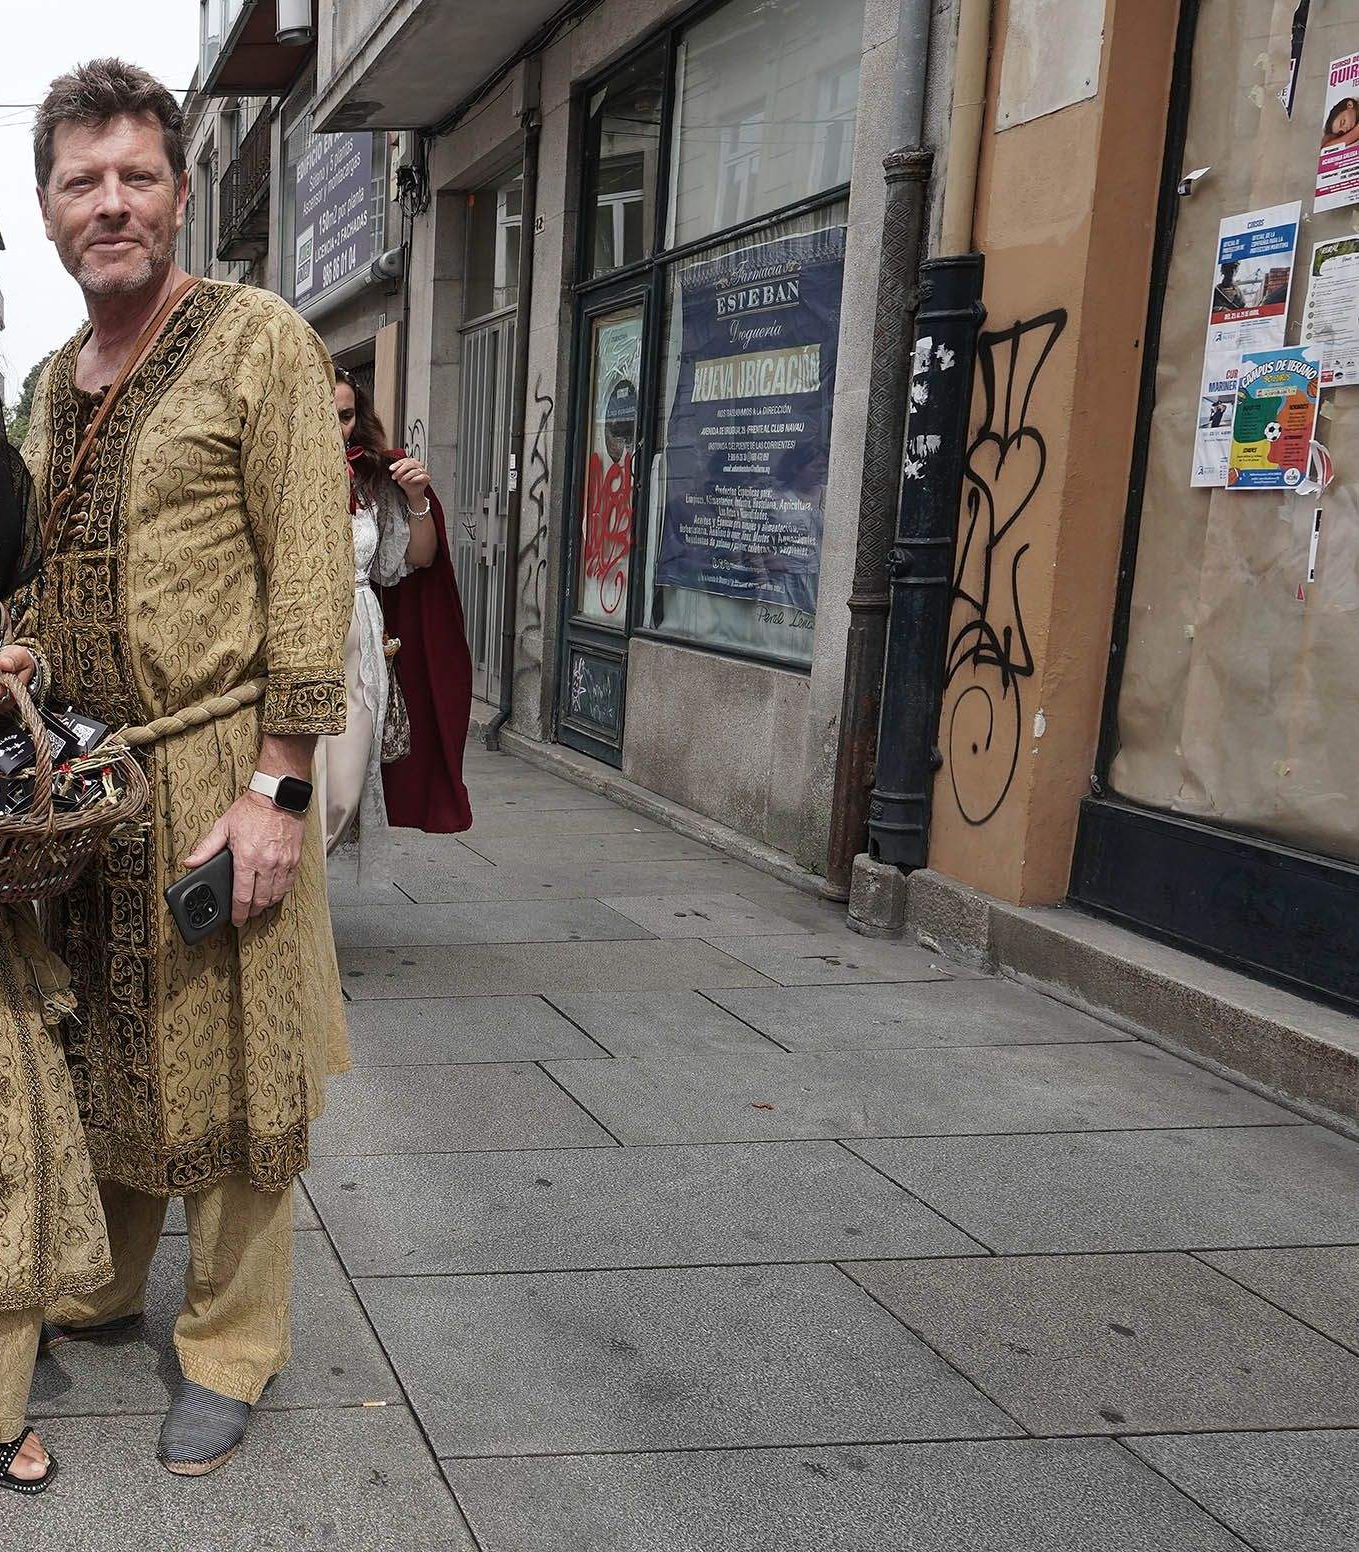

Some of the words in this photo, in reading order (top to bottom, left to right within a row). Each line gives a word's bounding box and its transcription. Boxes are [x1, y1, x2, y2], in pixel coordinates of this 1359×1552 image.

[297, 146, 322, 183] EDIFICIO
[340, 210, 368, 244] FACHADAS
[716, 280, 799, 315] ESTEBAN
[729, 319, 783, 350] Droguería
[691, 363, 734, 403] NUEVA
[737, 346, 821, 398] UBICACIÓN
[1209, 380, 1237, 393] MARINER
[1242, 361, 1274, 388] CAMPUS
[1275, 359, 1287, 371] DE
[1286, 359, 1319, 380] VERANO
